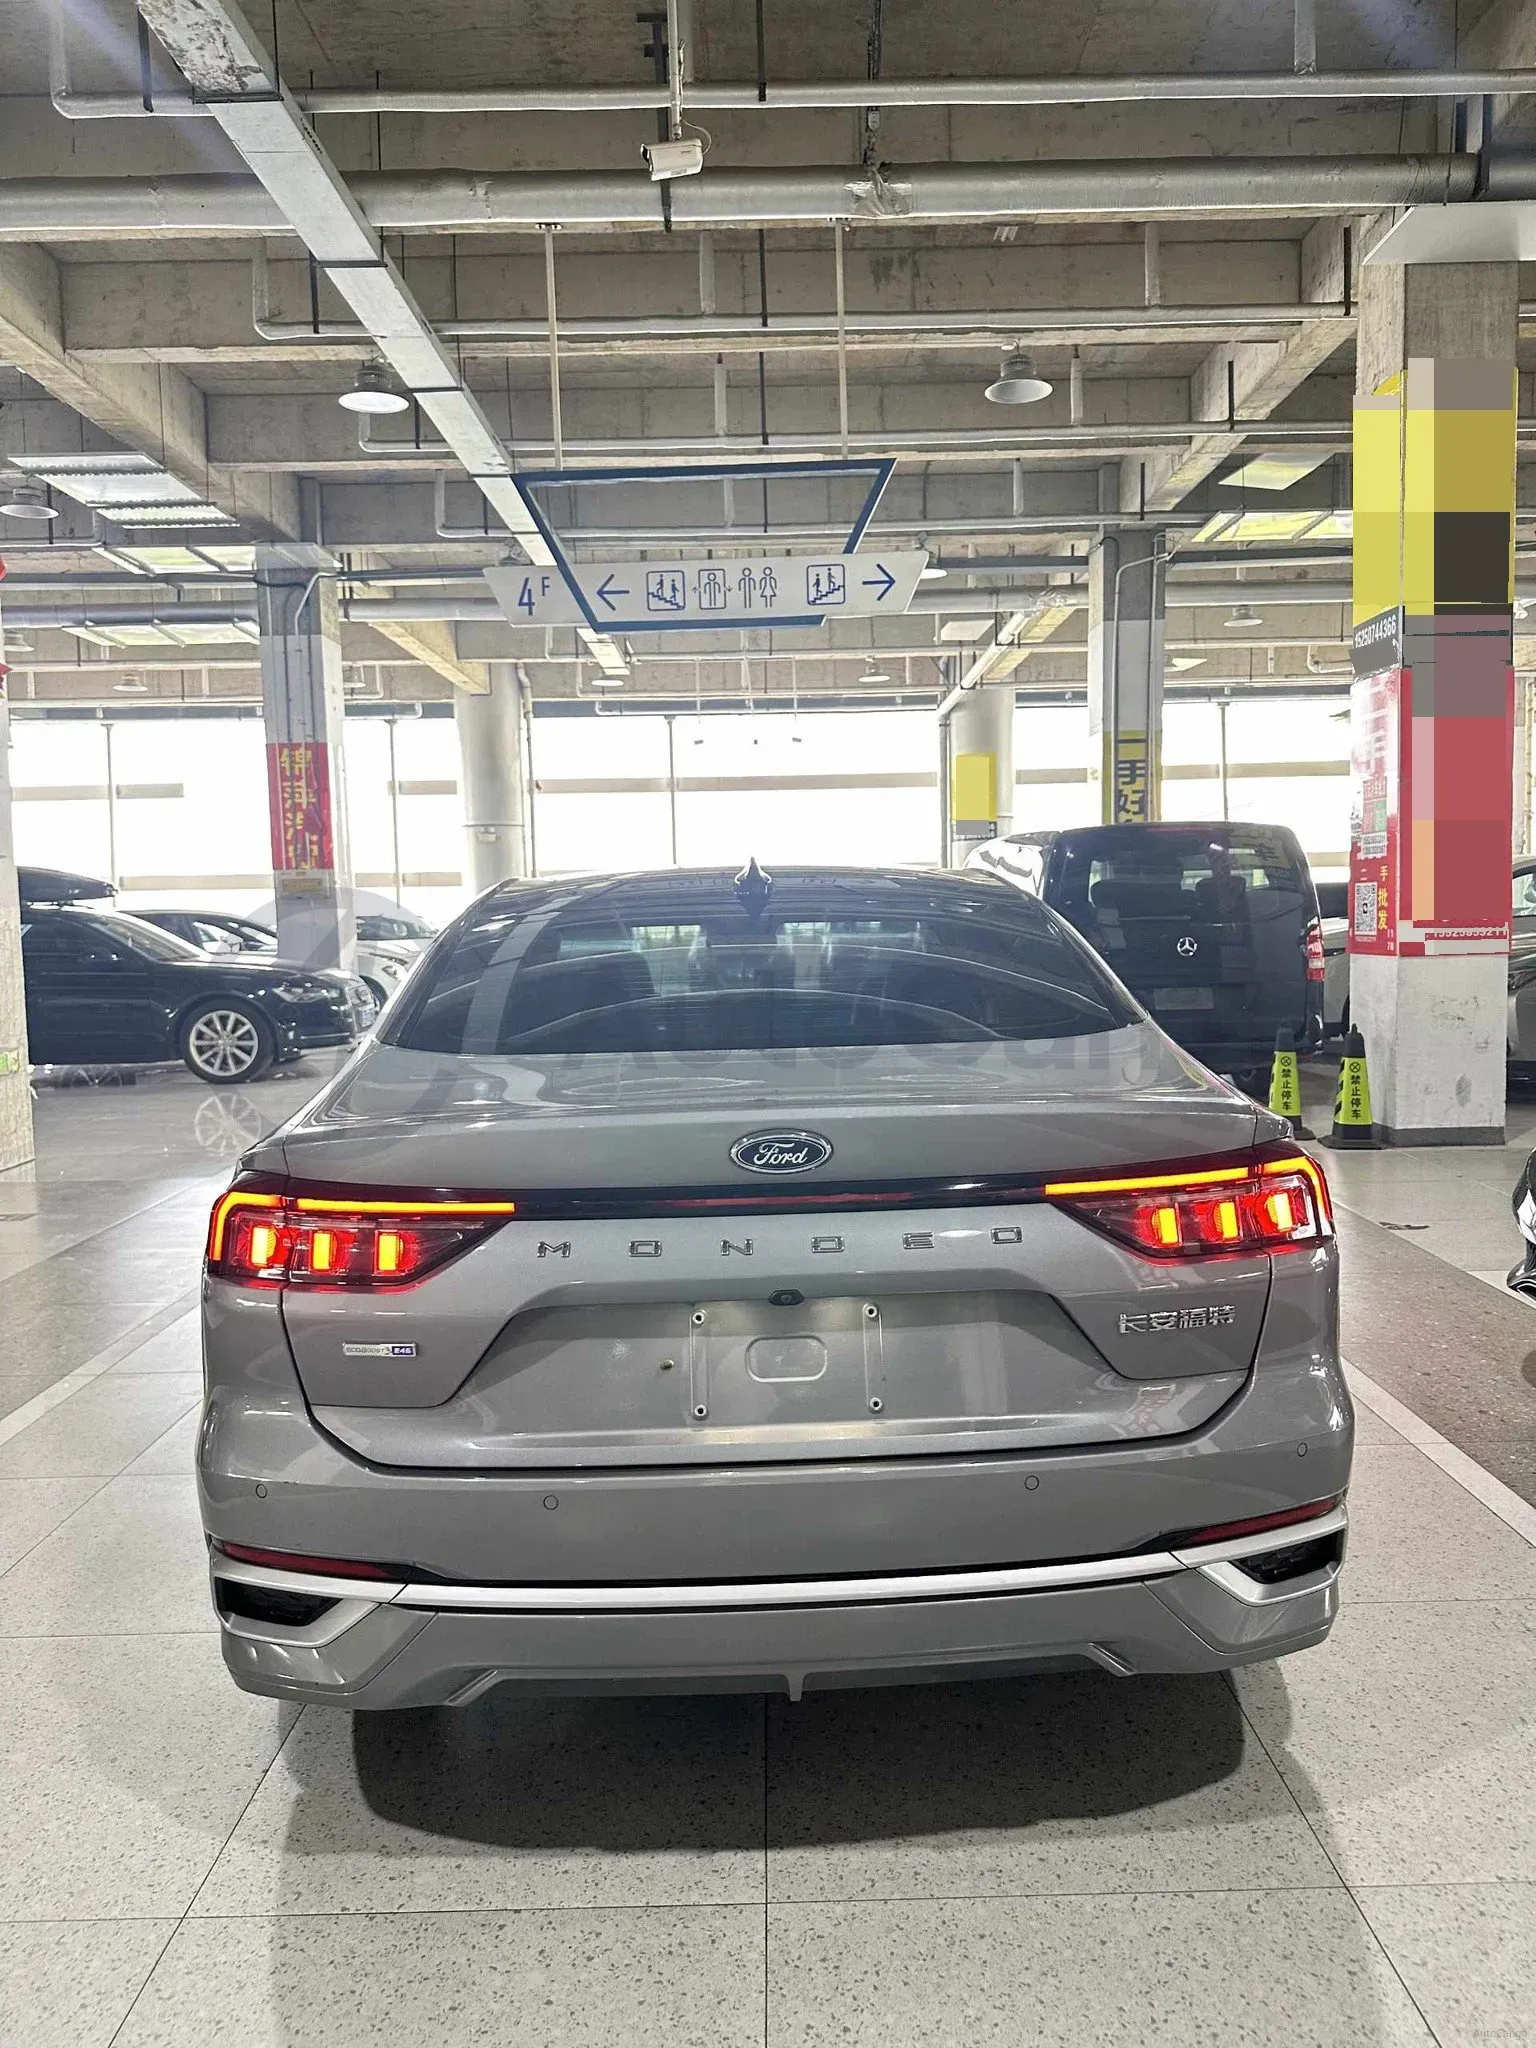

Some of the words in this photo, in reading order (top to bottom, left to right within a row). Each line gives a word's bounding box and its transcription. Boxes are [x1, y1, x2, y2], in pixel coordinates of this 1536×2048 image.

[518, 576, 550, 616] 4F
[1116, 738, 1148, 823] 二手好
[1282, 1069, 1292, 1111] 禁止停车
[1351, 1075, 1361, 1119] 禁止停车
[754, 1142, 809, 1165] Ford
[537, 1226, 1024, 1258] MONDEO
[1118, 1305, 1235, 1333] 长安福特
